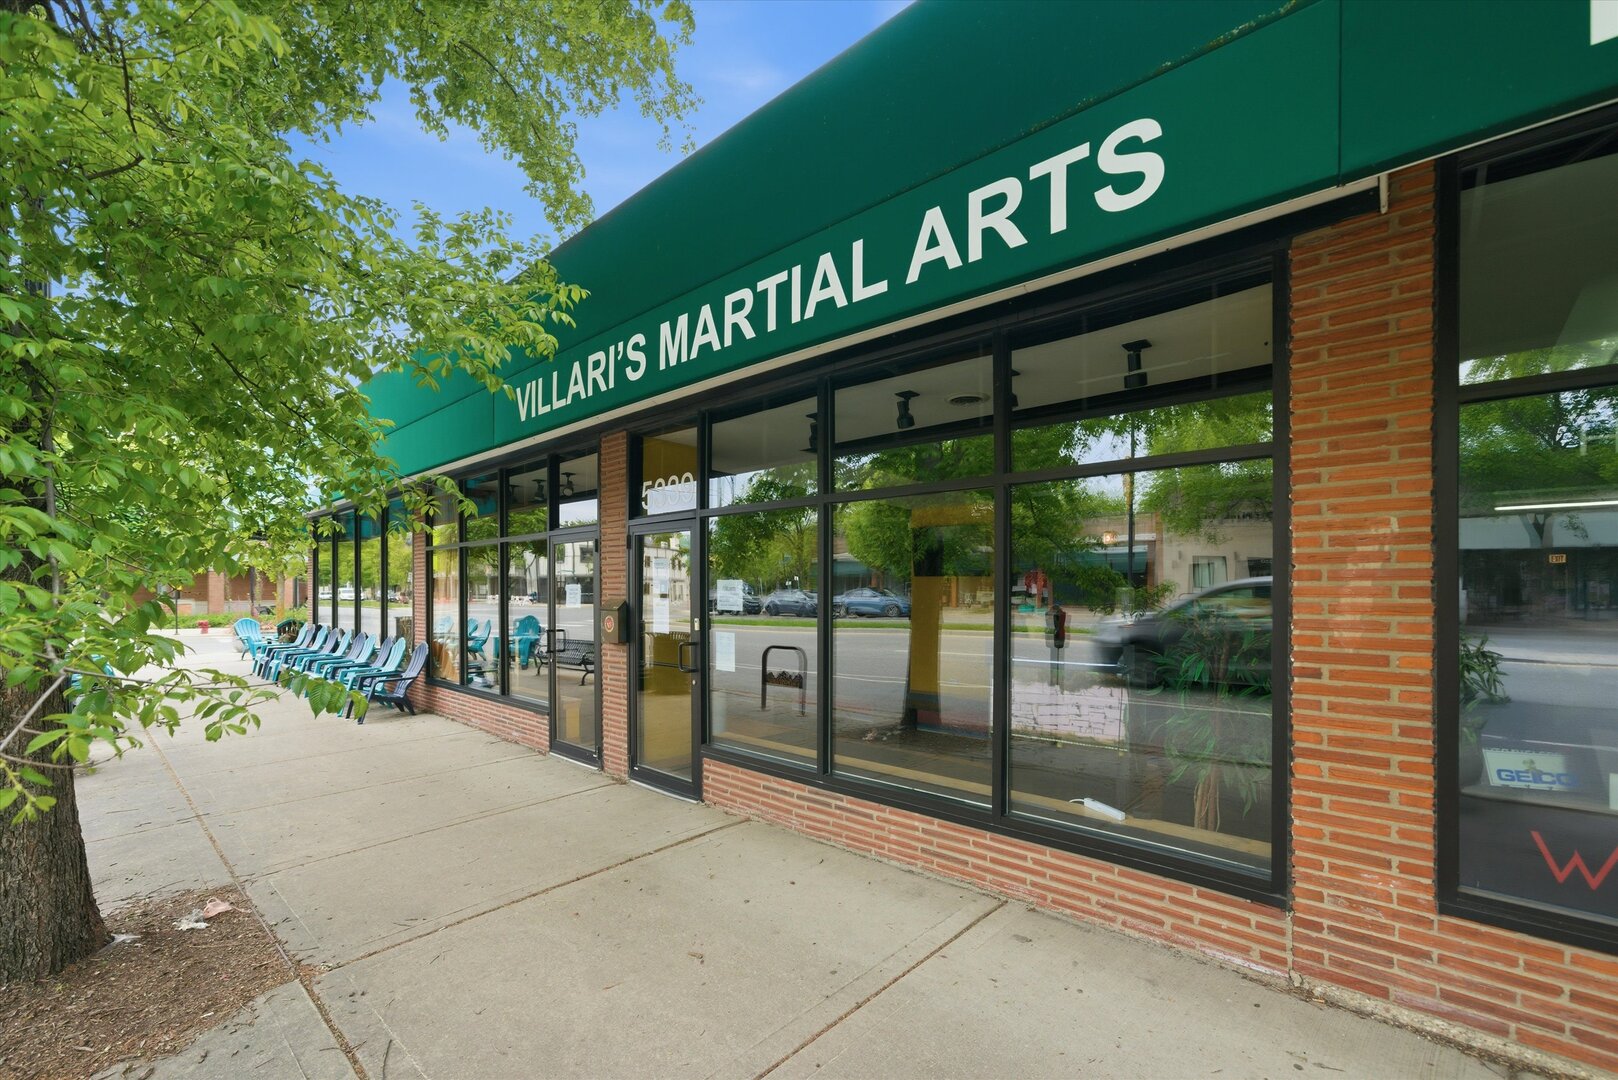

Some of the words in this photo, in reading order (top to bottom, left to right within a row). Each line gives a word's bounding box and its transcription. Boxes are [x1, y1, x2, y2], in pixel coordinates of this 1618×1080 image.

[515, 332, 647, 423] VILLARI’S
[659, 238, 889, 371] MARTIAL
[905, 117, 1166, 285] ARTS
[1496, 768, 1579, 788] GEICO
